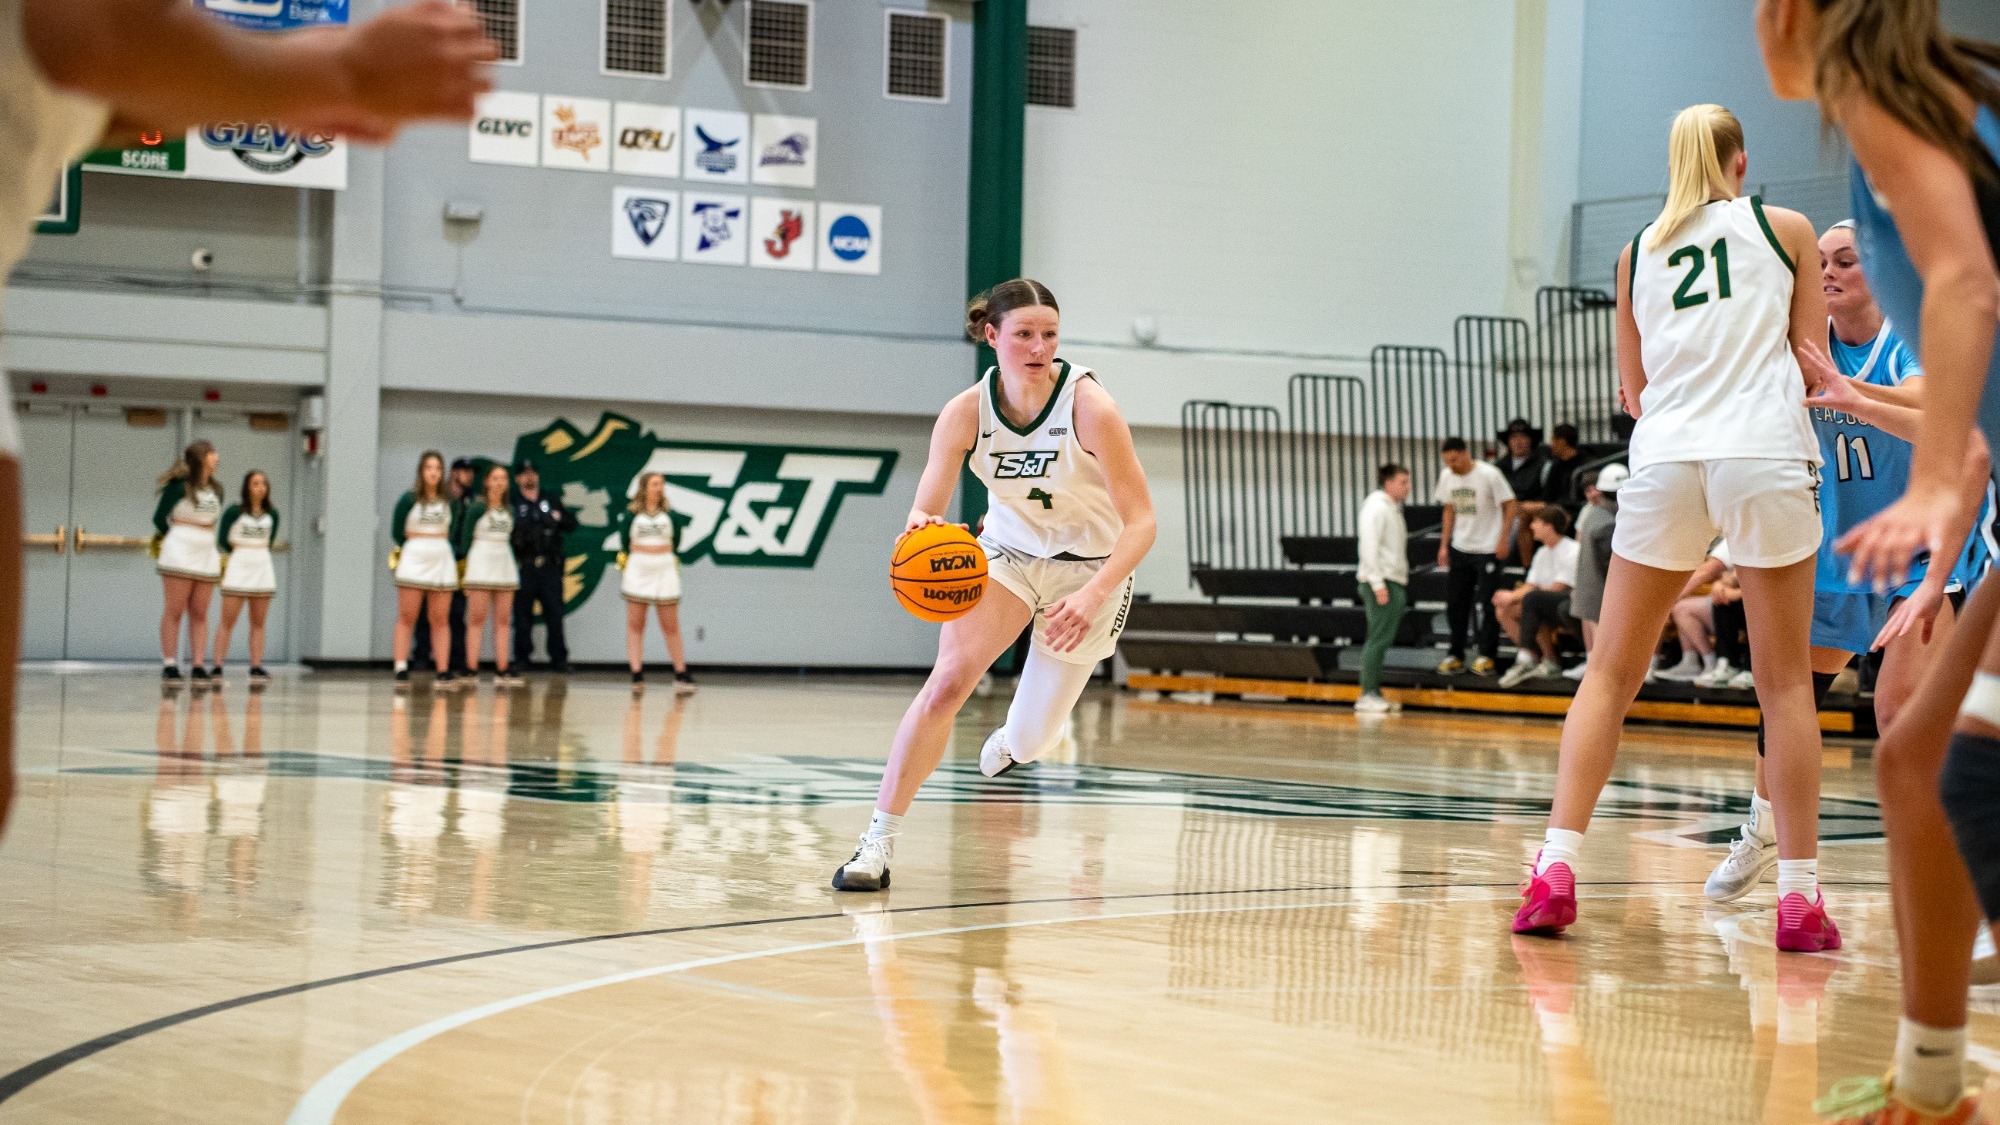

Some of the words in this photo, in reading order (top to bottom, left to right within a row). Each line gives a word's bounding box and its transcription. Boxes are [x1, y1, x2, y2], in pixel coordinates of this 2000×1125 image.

[477, 118, 533, 137] GLVC
[121, 150, 169, 170] SCORE
[1667, 237, 1732, 311] 21
[990, 451, 1059, 478] S&T
[1835, 431, 1875, 482] 11
[602, 447, 884, 558] S&T
[1027, 488, 1053, 509] 4
[930, 555, 976, 573] NCAA
[923, 583, 982, 605] Wilson
